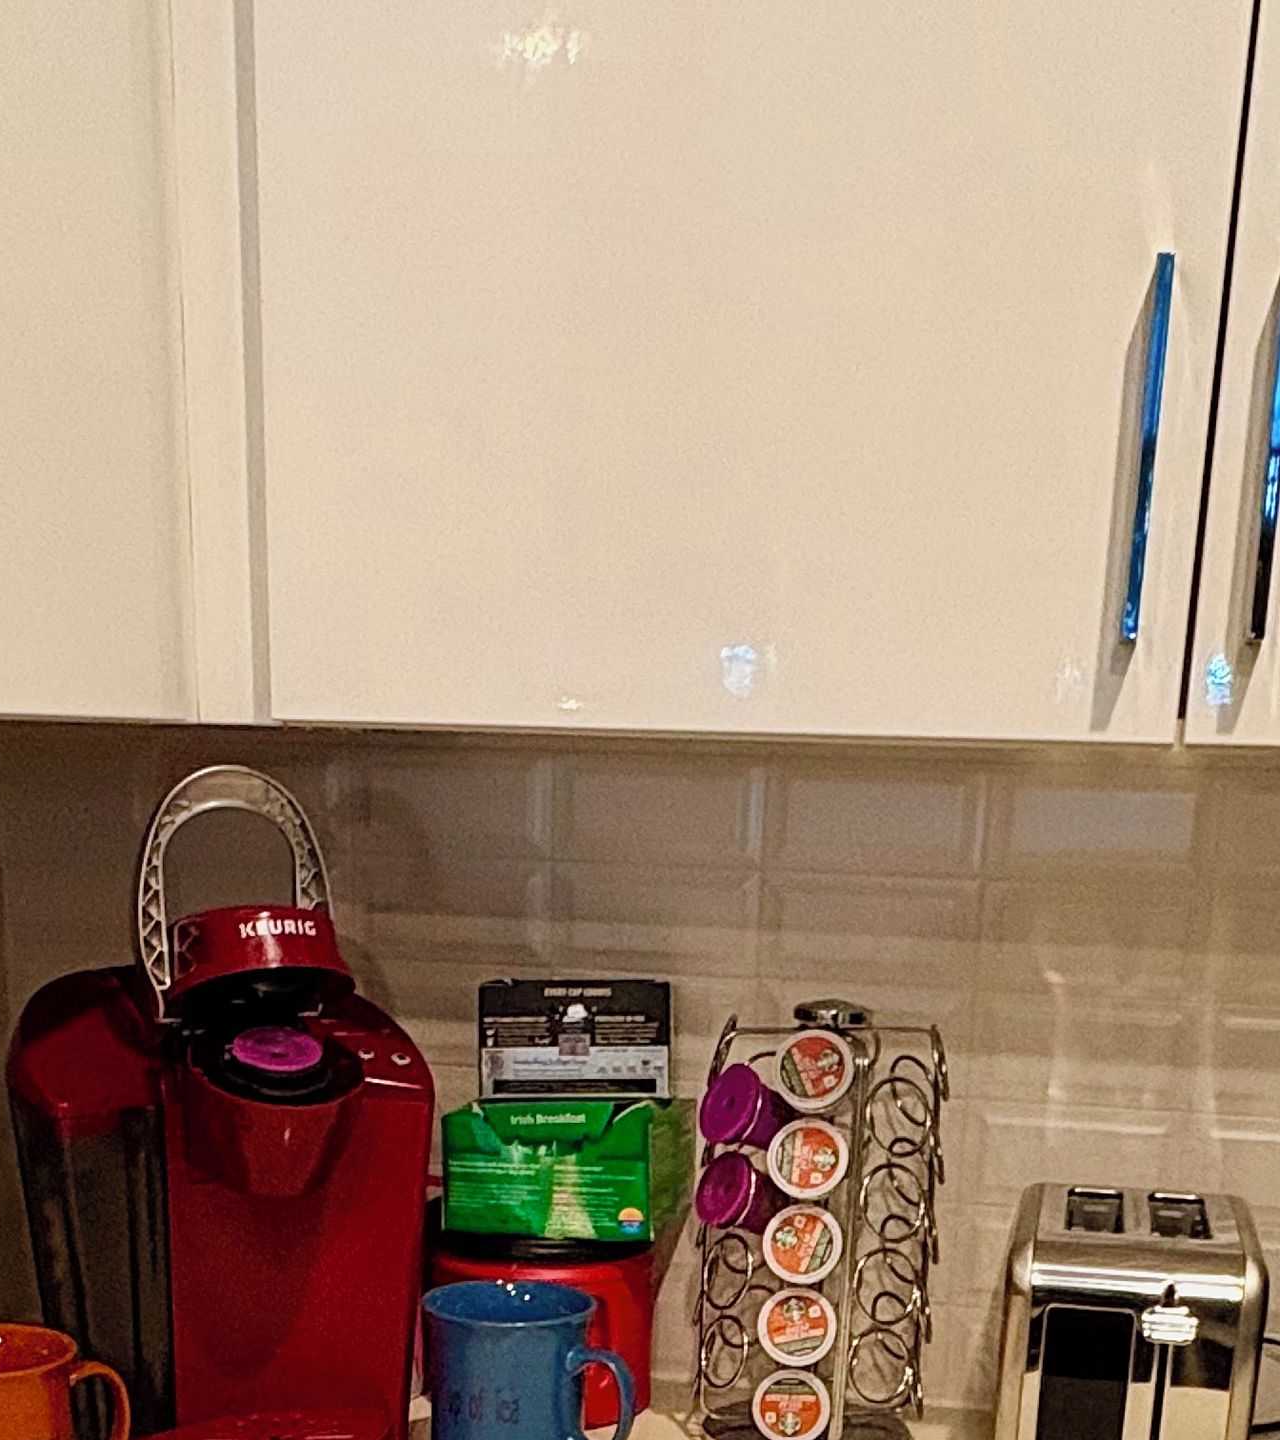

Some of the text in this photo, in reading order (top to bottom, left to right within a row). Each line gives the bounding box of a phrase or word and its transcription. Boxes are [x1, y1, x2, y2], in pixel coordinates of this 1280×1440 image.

[239, 919, 317, 939] KEURIG
[510, 1113, 587, 1125] Irish Breakfast
